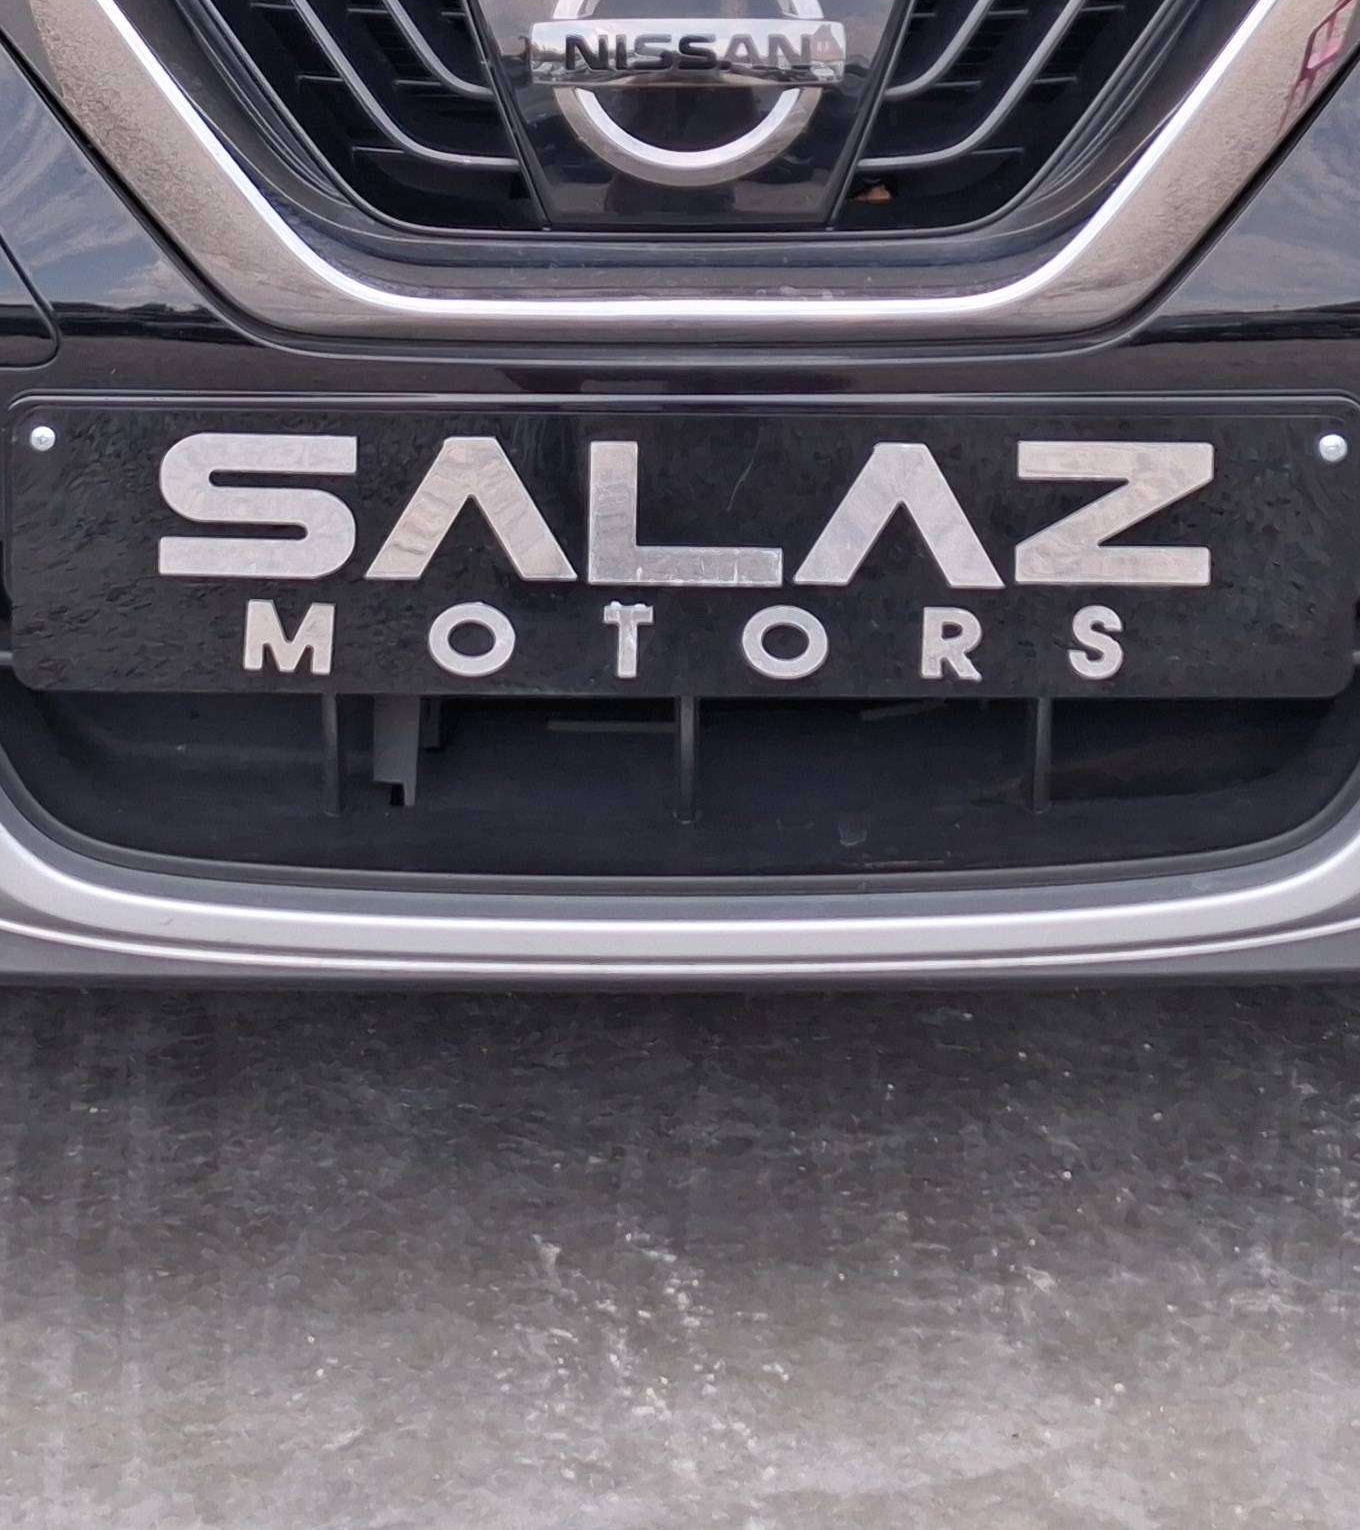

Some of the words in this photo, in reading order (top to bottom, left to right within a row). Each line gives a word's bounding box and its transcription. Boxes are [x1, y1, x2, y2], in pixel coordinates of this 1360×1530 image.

[564, 33, 812, 72] NISSAN
[158, 433, 1214, 589] SALAZ
[243, 600, 1125, 682] MOTORS
